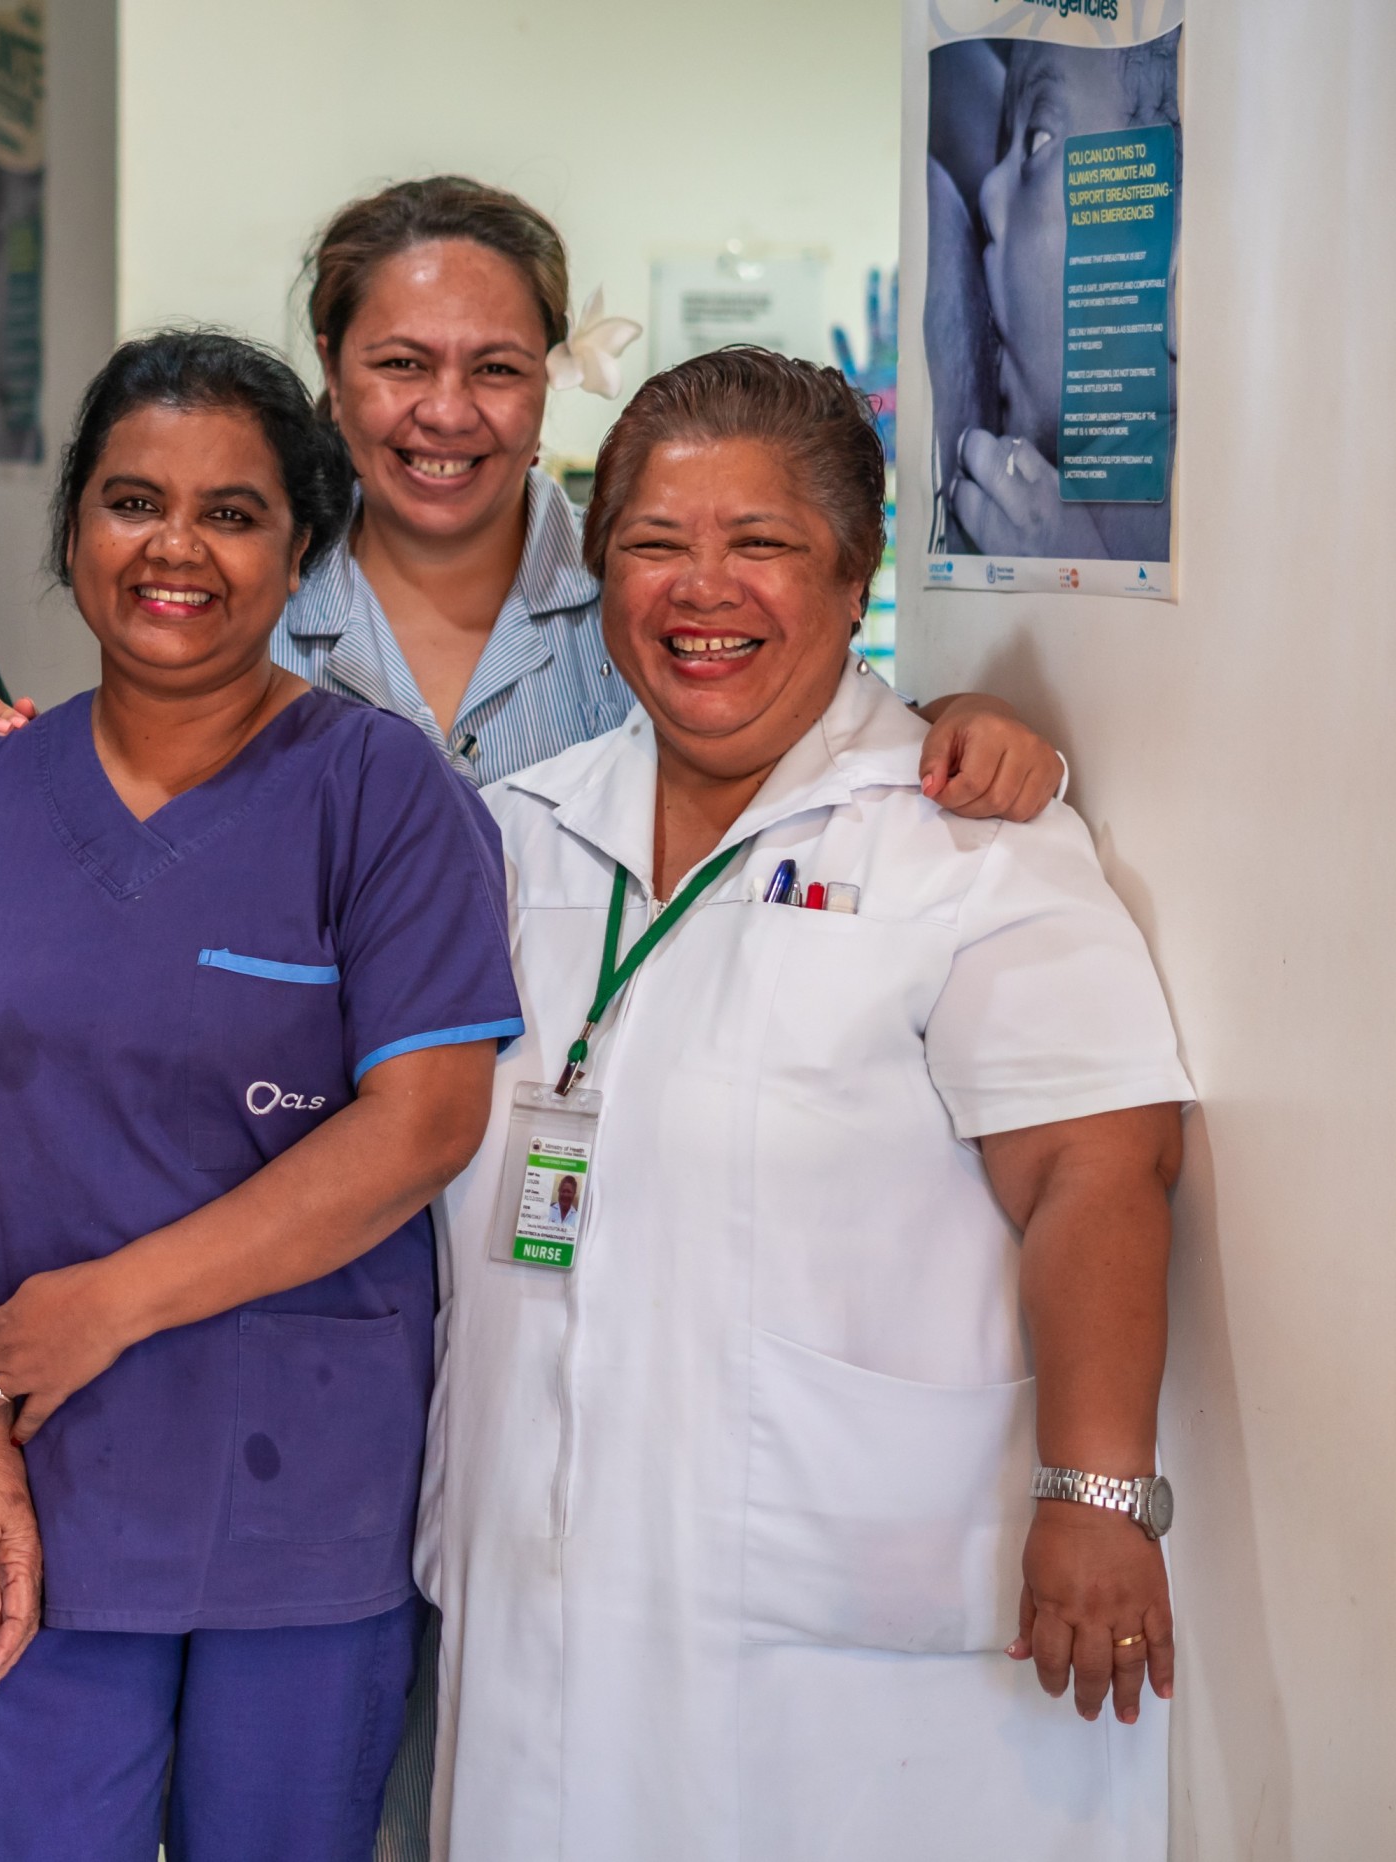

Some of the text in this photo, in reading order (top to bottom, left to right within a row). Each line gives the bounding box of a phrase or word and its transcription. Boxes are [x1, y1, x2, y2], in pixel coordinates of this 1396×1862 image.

[1023, 0, 1118, 21] gencies
[1068, 143, 1146, 166] YOU CAN DO THIS TO
[1068, 163, 1156, 186] ALWAYS PROMOTE AND
[1069, 189, 1104, 206] SUPPORT
[1072, 204, 1154, 226] ALSO IN EMERGENCIES
[523, 1243, 563, 1262] NURSE
